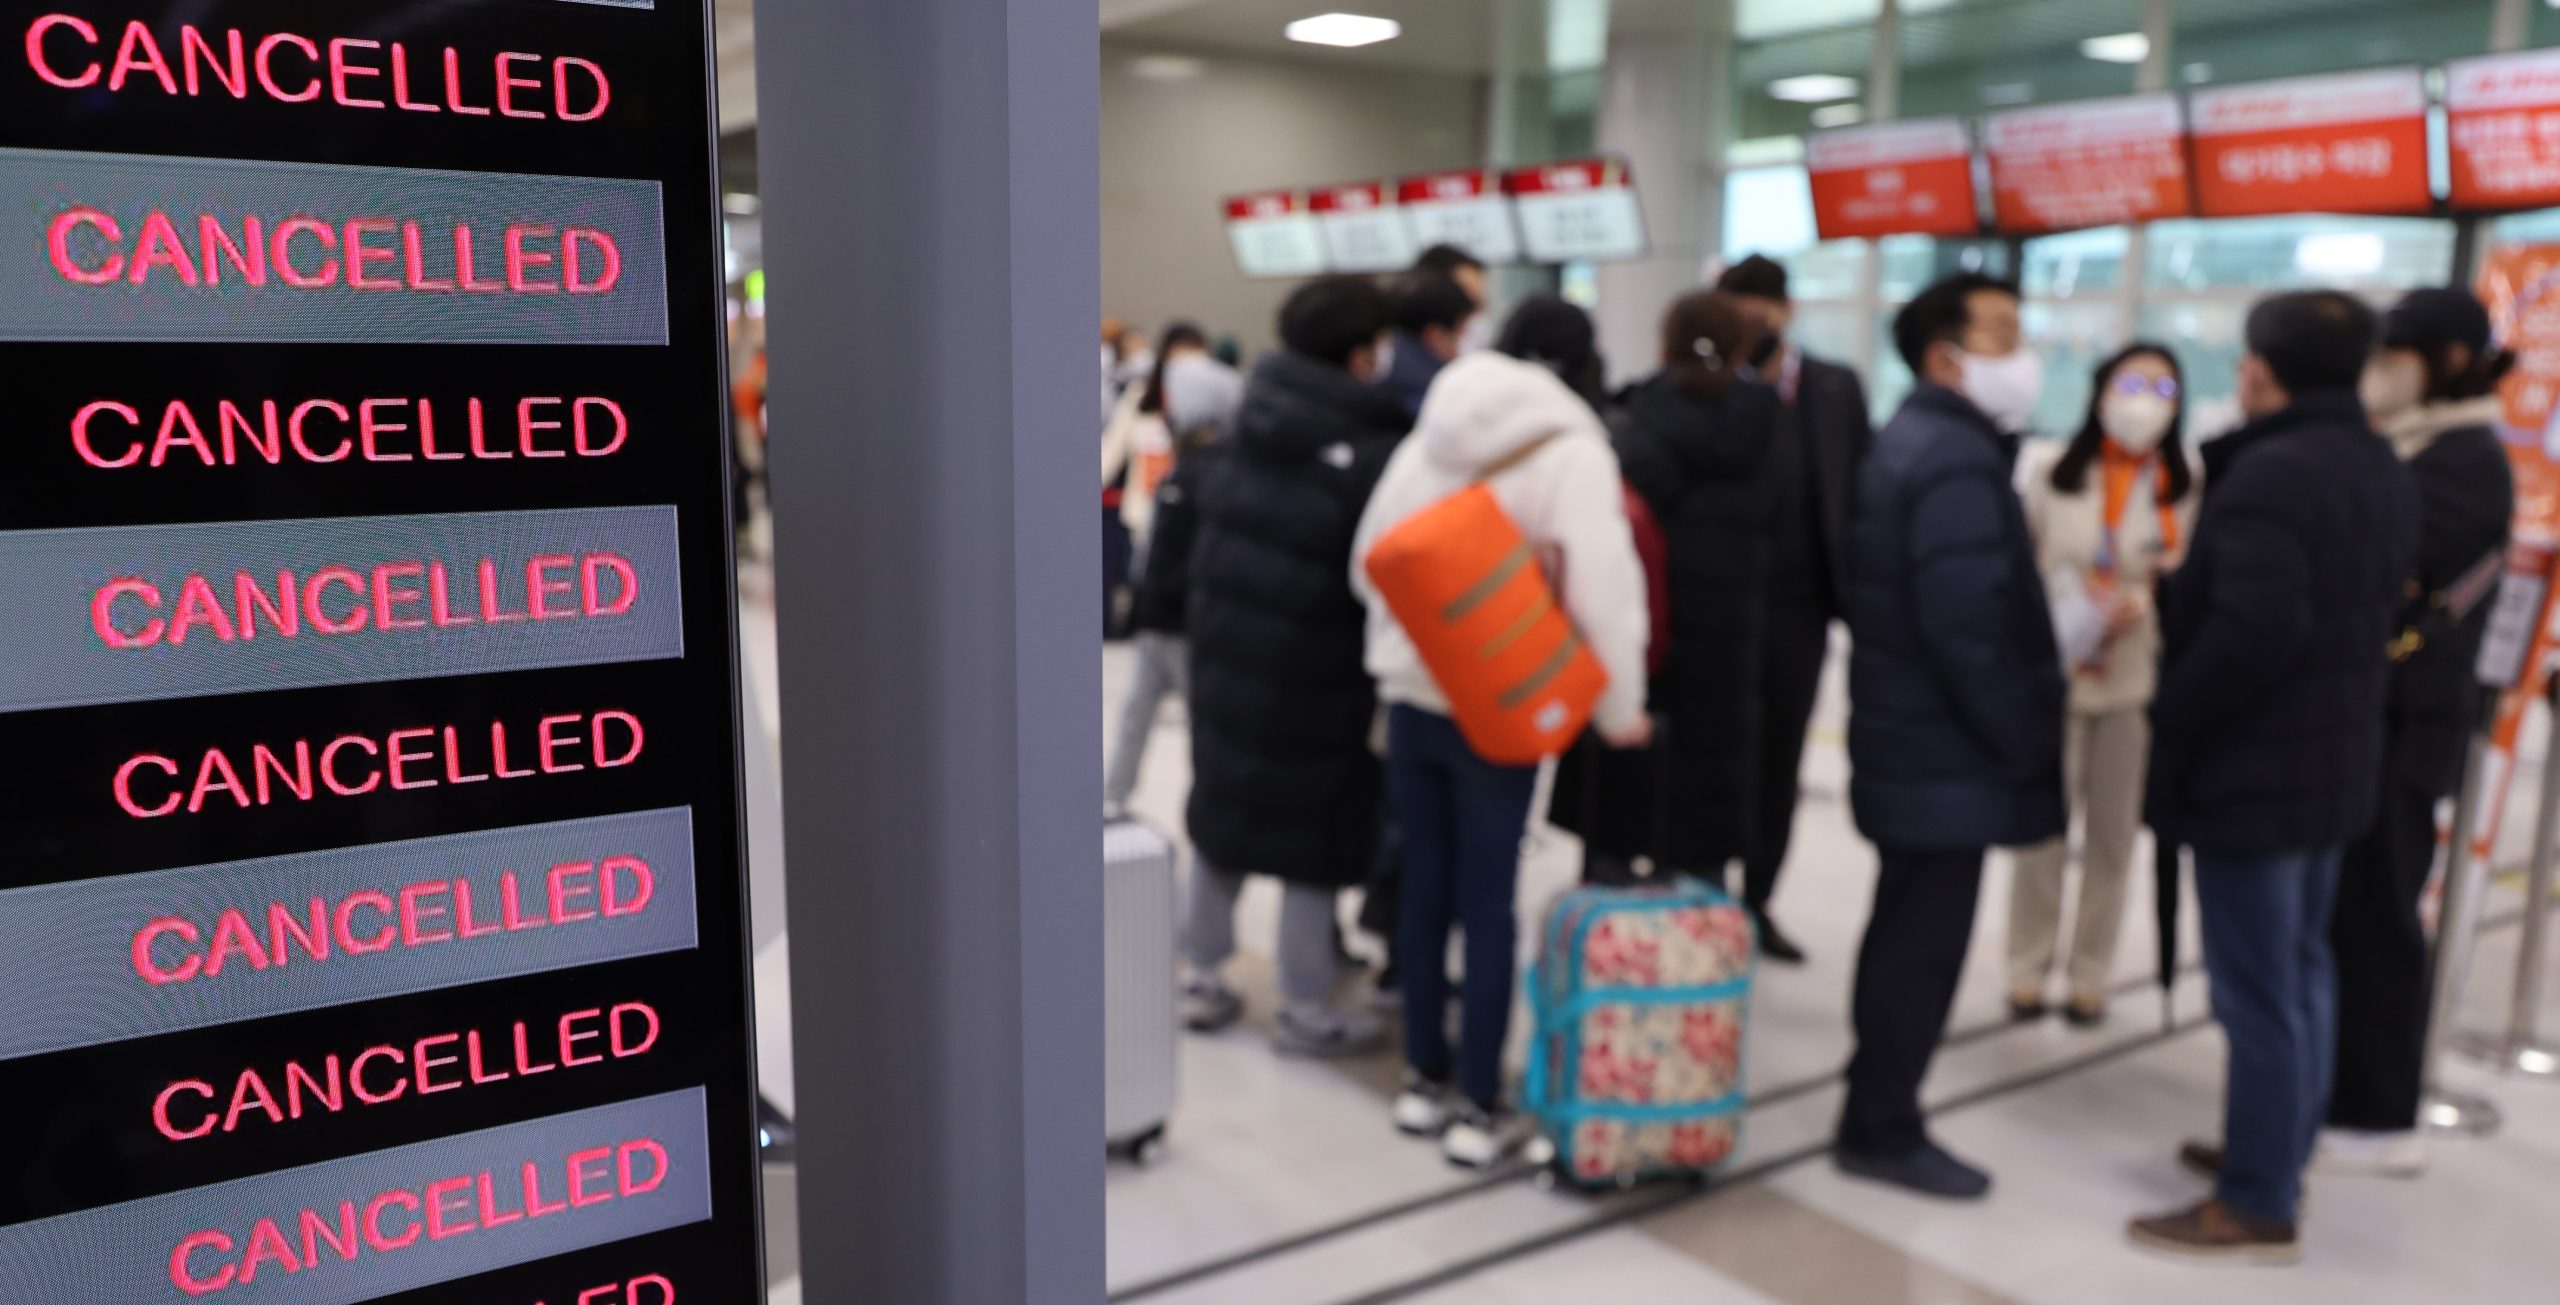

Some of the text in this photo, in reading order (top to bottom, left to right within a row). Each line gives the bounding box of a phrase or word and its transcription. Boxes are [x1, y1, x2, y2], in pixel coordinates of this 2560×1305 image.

[26, 13, 610, 121] CANCELLED
[47, 206, 622, 294] CANCELLED
[71, 396, 628, 467] CANCELLED
[91, 552, 639, 648] CANCELLED
[113, 710, 644, 818] CANCELLED
[132, 854, 655, 985] CANCELLED
[153, 1001, 660, 1141] CANCELLED
[169, 1137, 669, 1296] CANCELLED
